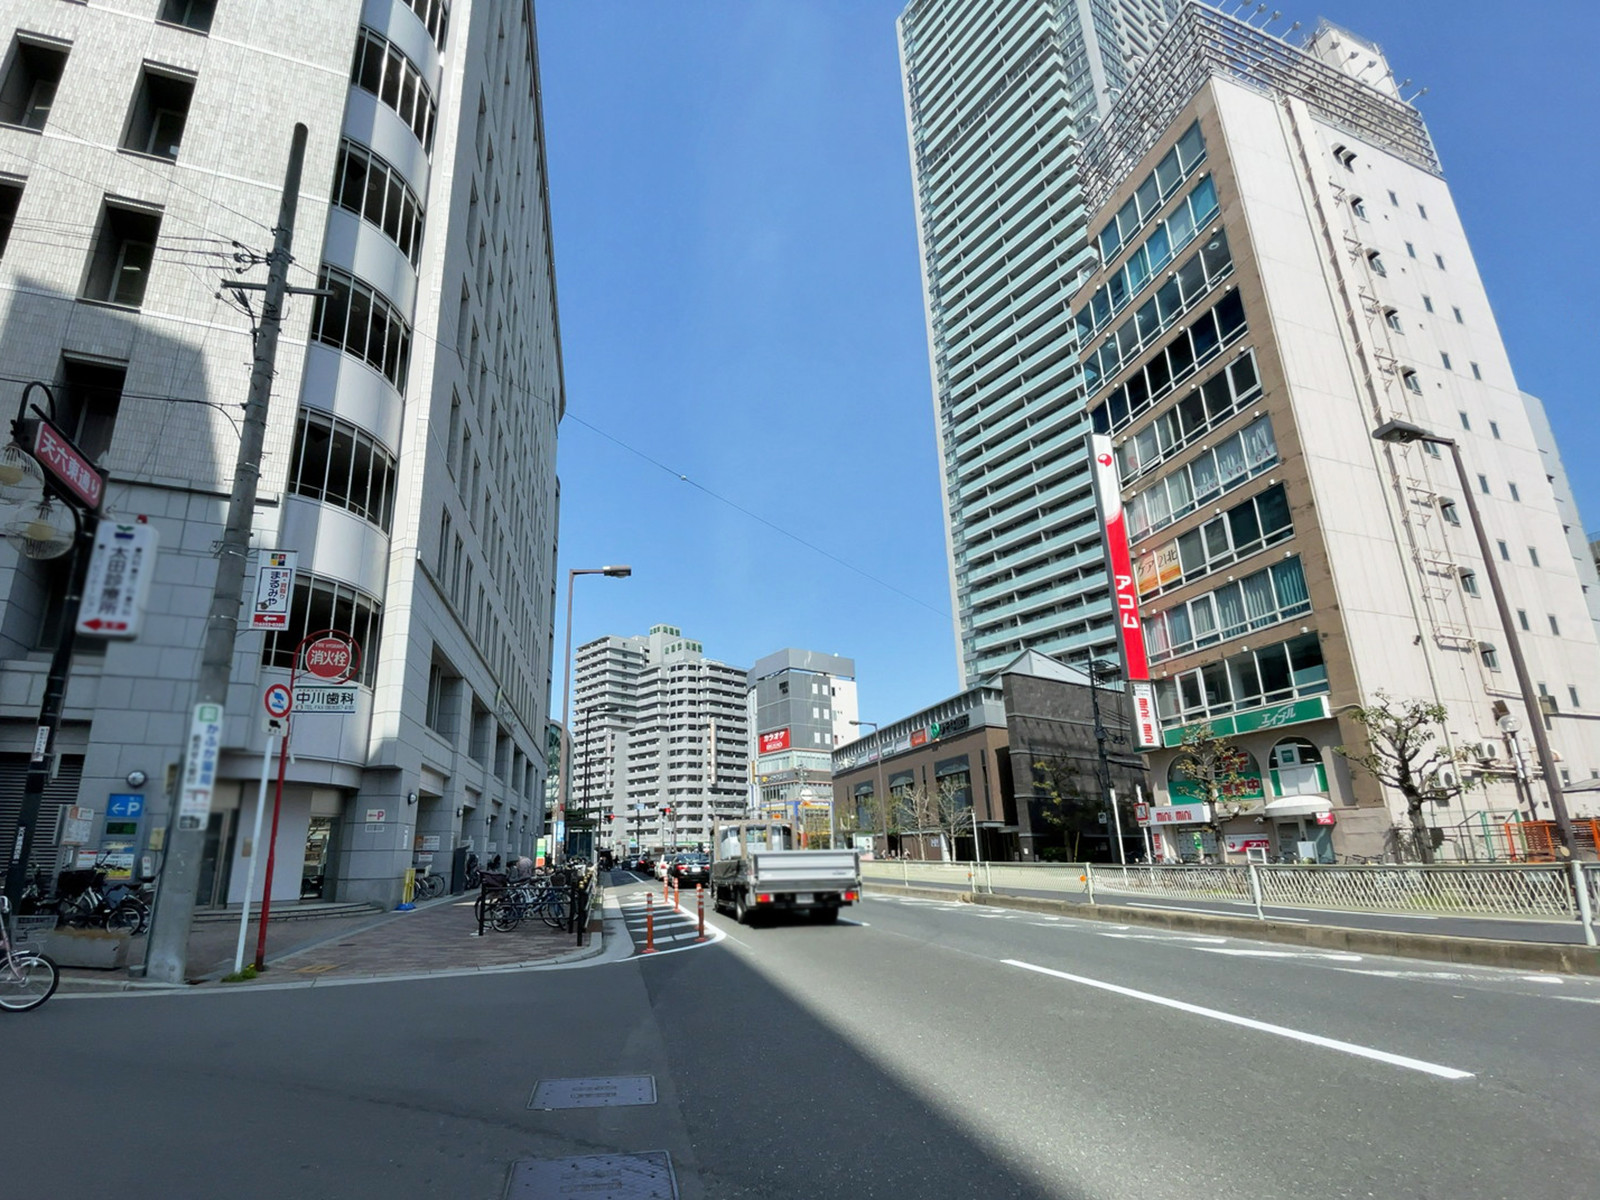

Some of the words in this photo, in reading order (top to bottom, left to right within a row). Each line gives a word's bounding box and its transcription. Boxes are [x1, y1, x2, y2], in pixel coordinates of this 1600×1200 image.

[41, 432, 100, 499] 天六東通り
[267, 571, 281, 606] まるみや
[1115, 574, 1139, 629] アコム
[310, 650, 348, 666] 消火栓
[296, 692, 355, 705] 中川歯科
[1260, 706, 1297, 726] エイブル
[127, 802, 140, 816] P
